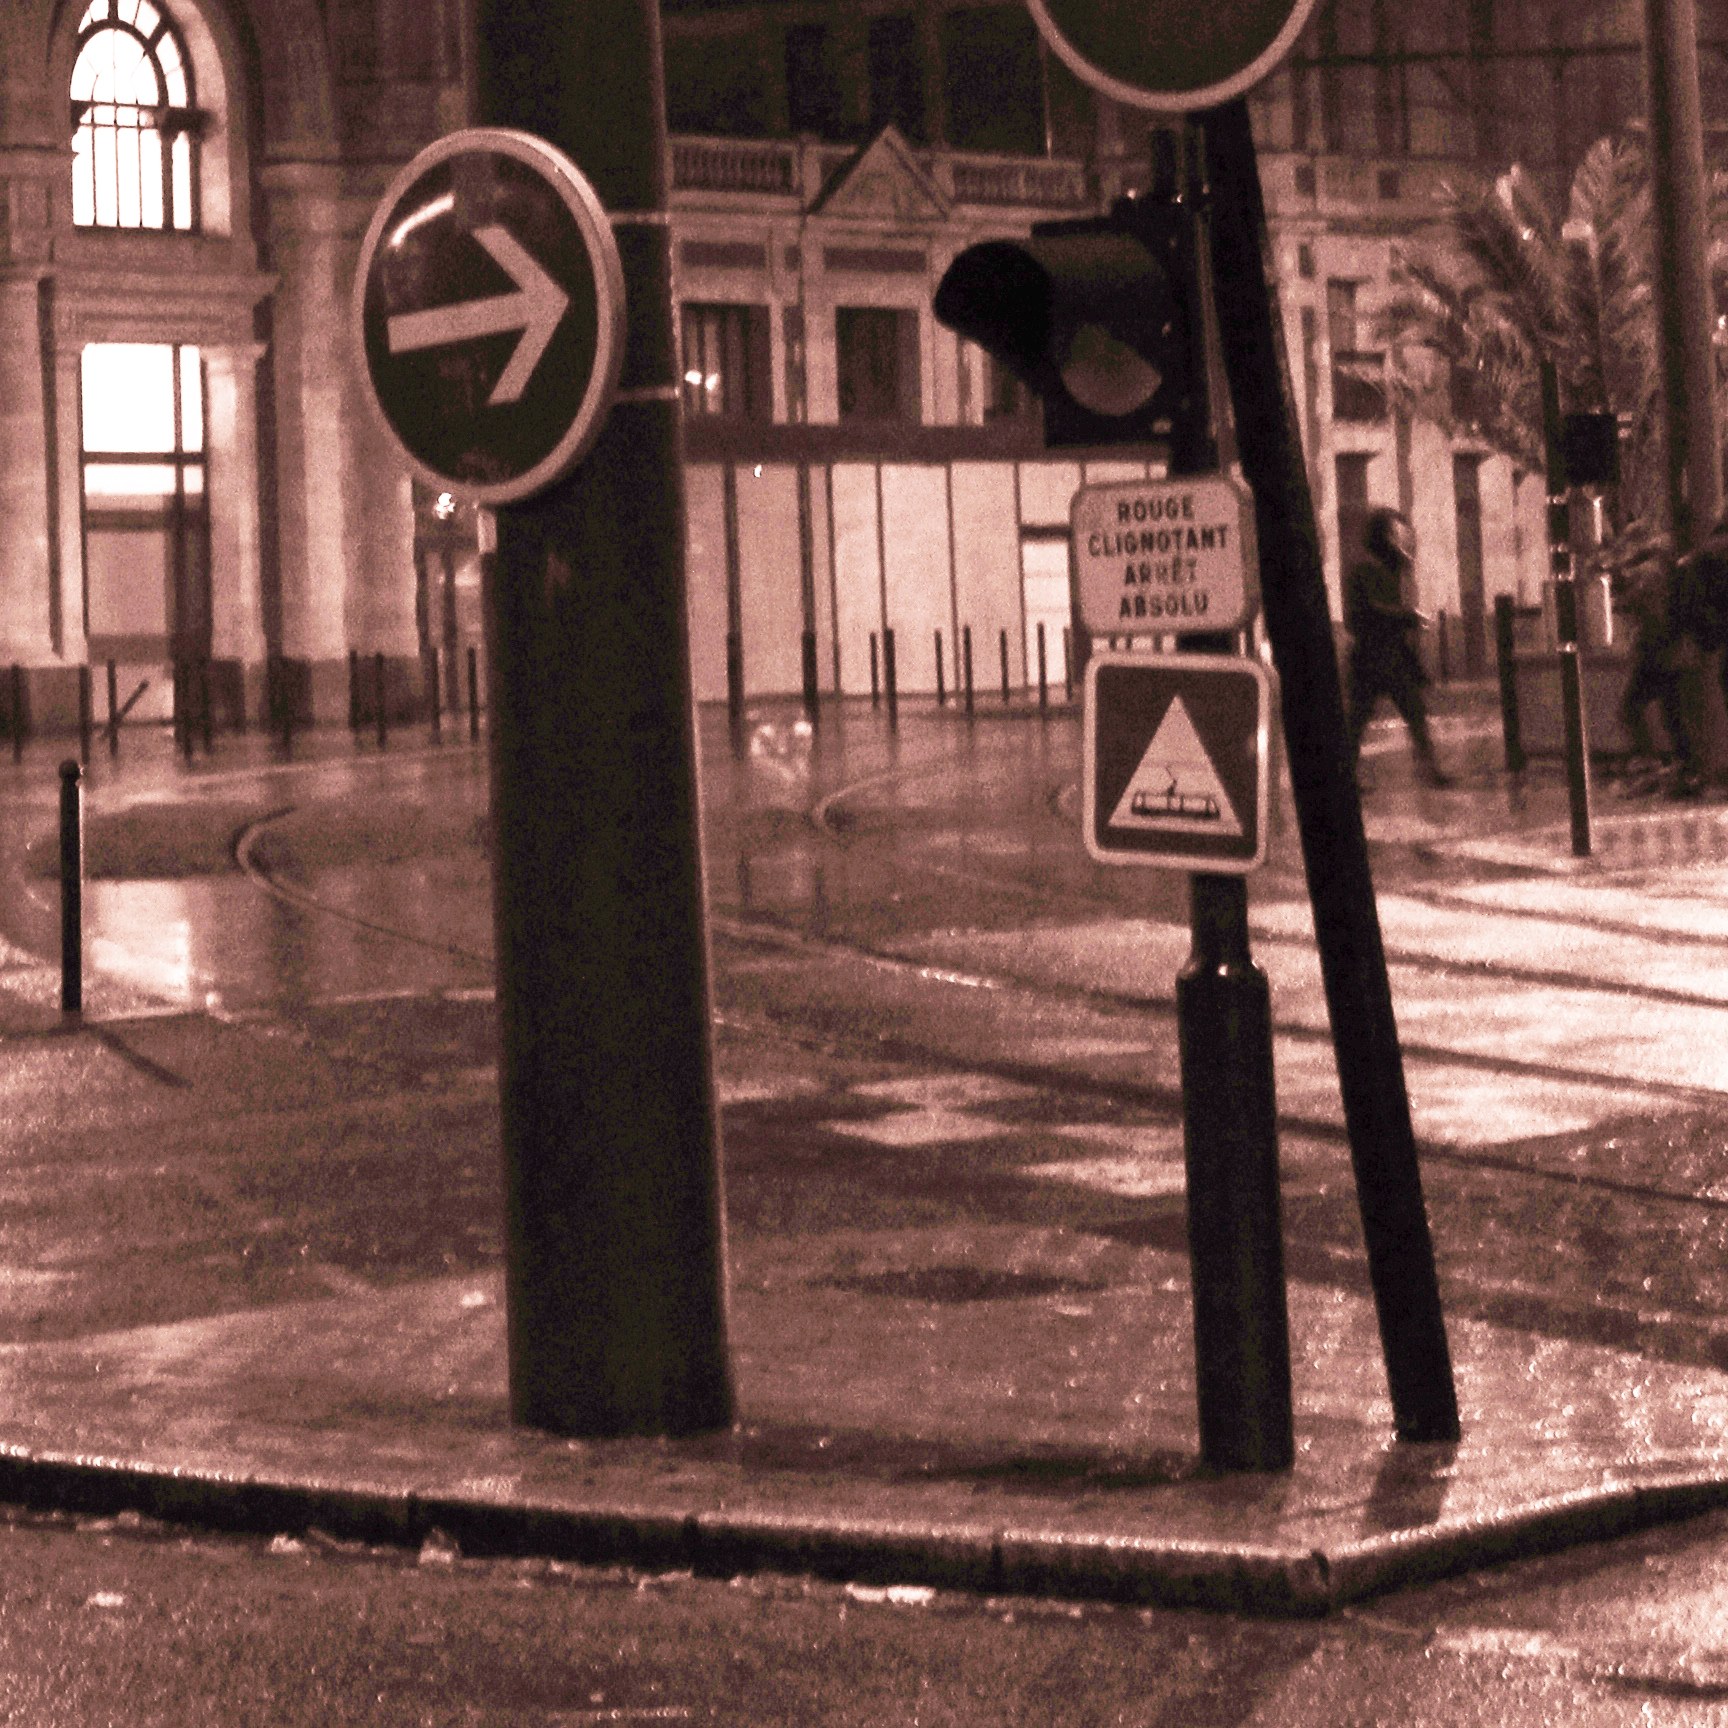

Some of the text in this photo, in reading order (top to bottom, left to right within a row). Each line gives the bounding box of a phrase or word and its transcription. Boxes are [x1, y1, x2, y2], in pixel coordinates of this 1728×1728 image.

[1116, 494, 1195, 522] ROUGE
[1088, 524, 1229, 557] CLIGNOTANT
[1119, 590, 1209, 619] ABSOLU
